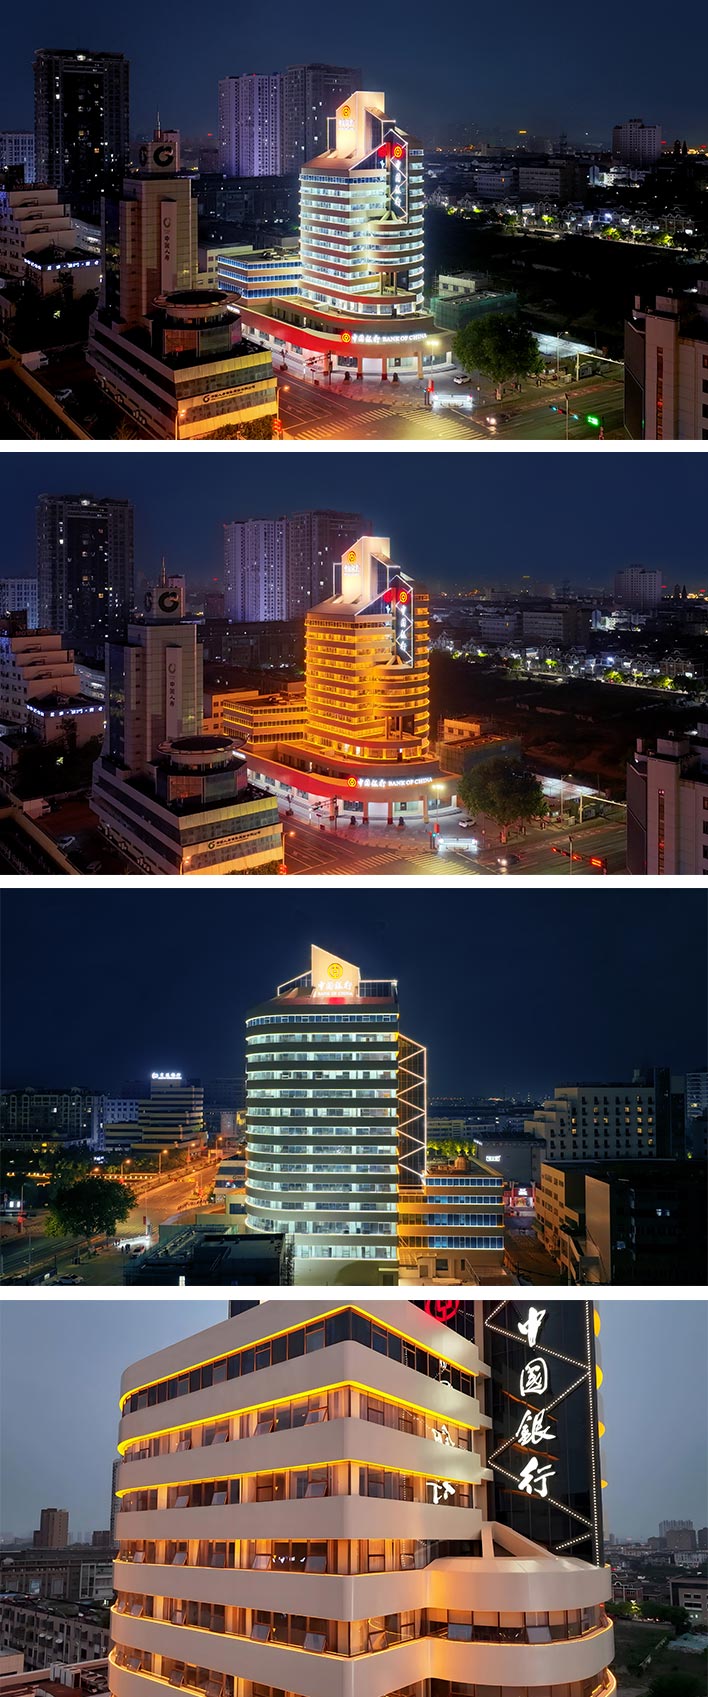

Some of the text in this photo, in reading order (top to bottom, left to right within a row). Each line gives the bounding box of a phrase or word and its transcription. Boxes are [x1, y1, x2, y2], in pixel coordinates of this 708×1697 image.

[408, 332, 427, 340] CHINA
[414, 777, 432, 785] CHINA
[516, 1306, 556, 1498] 中國銀行
